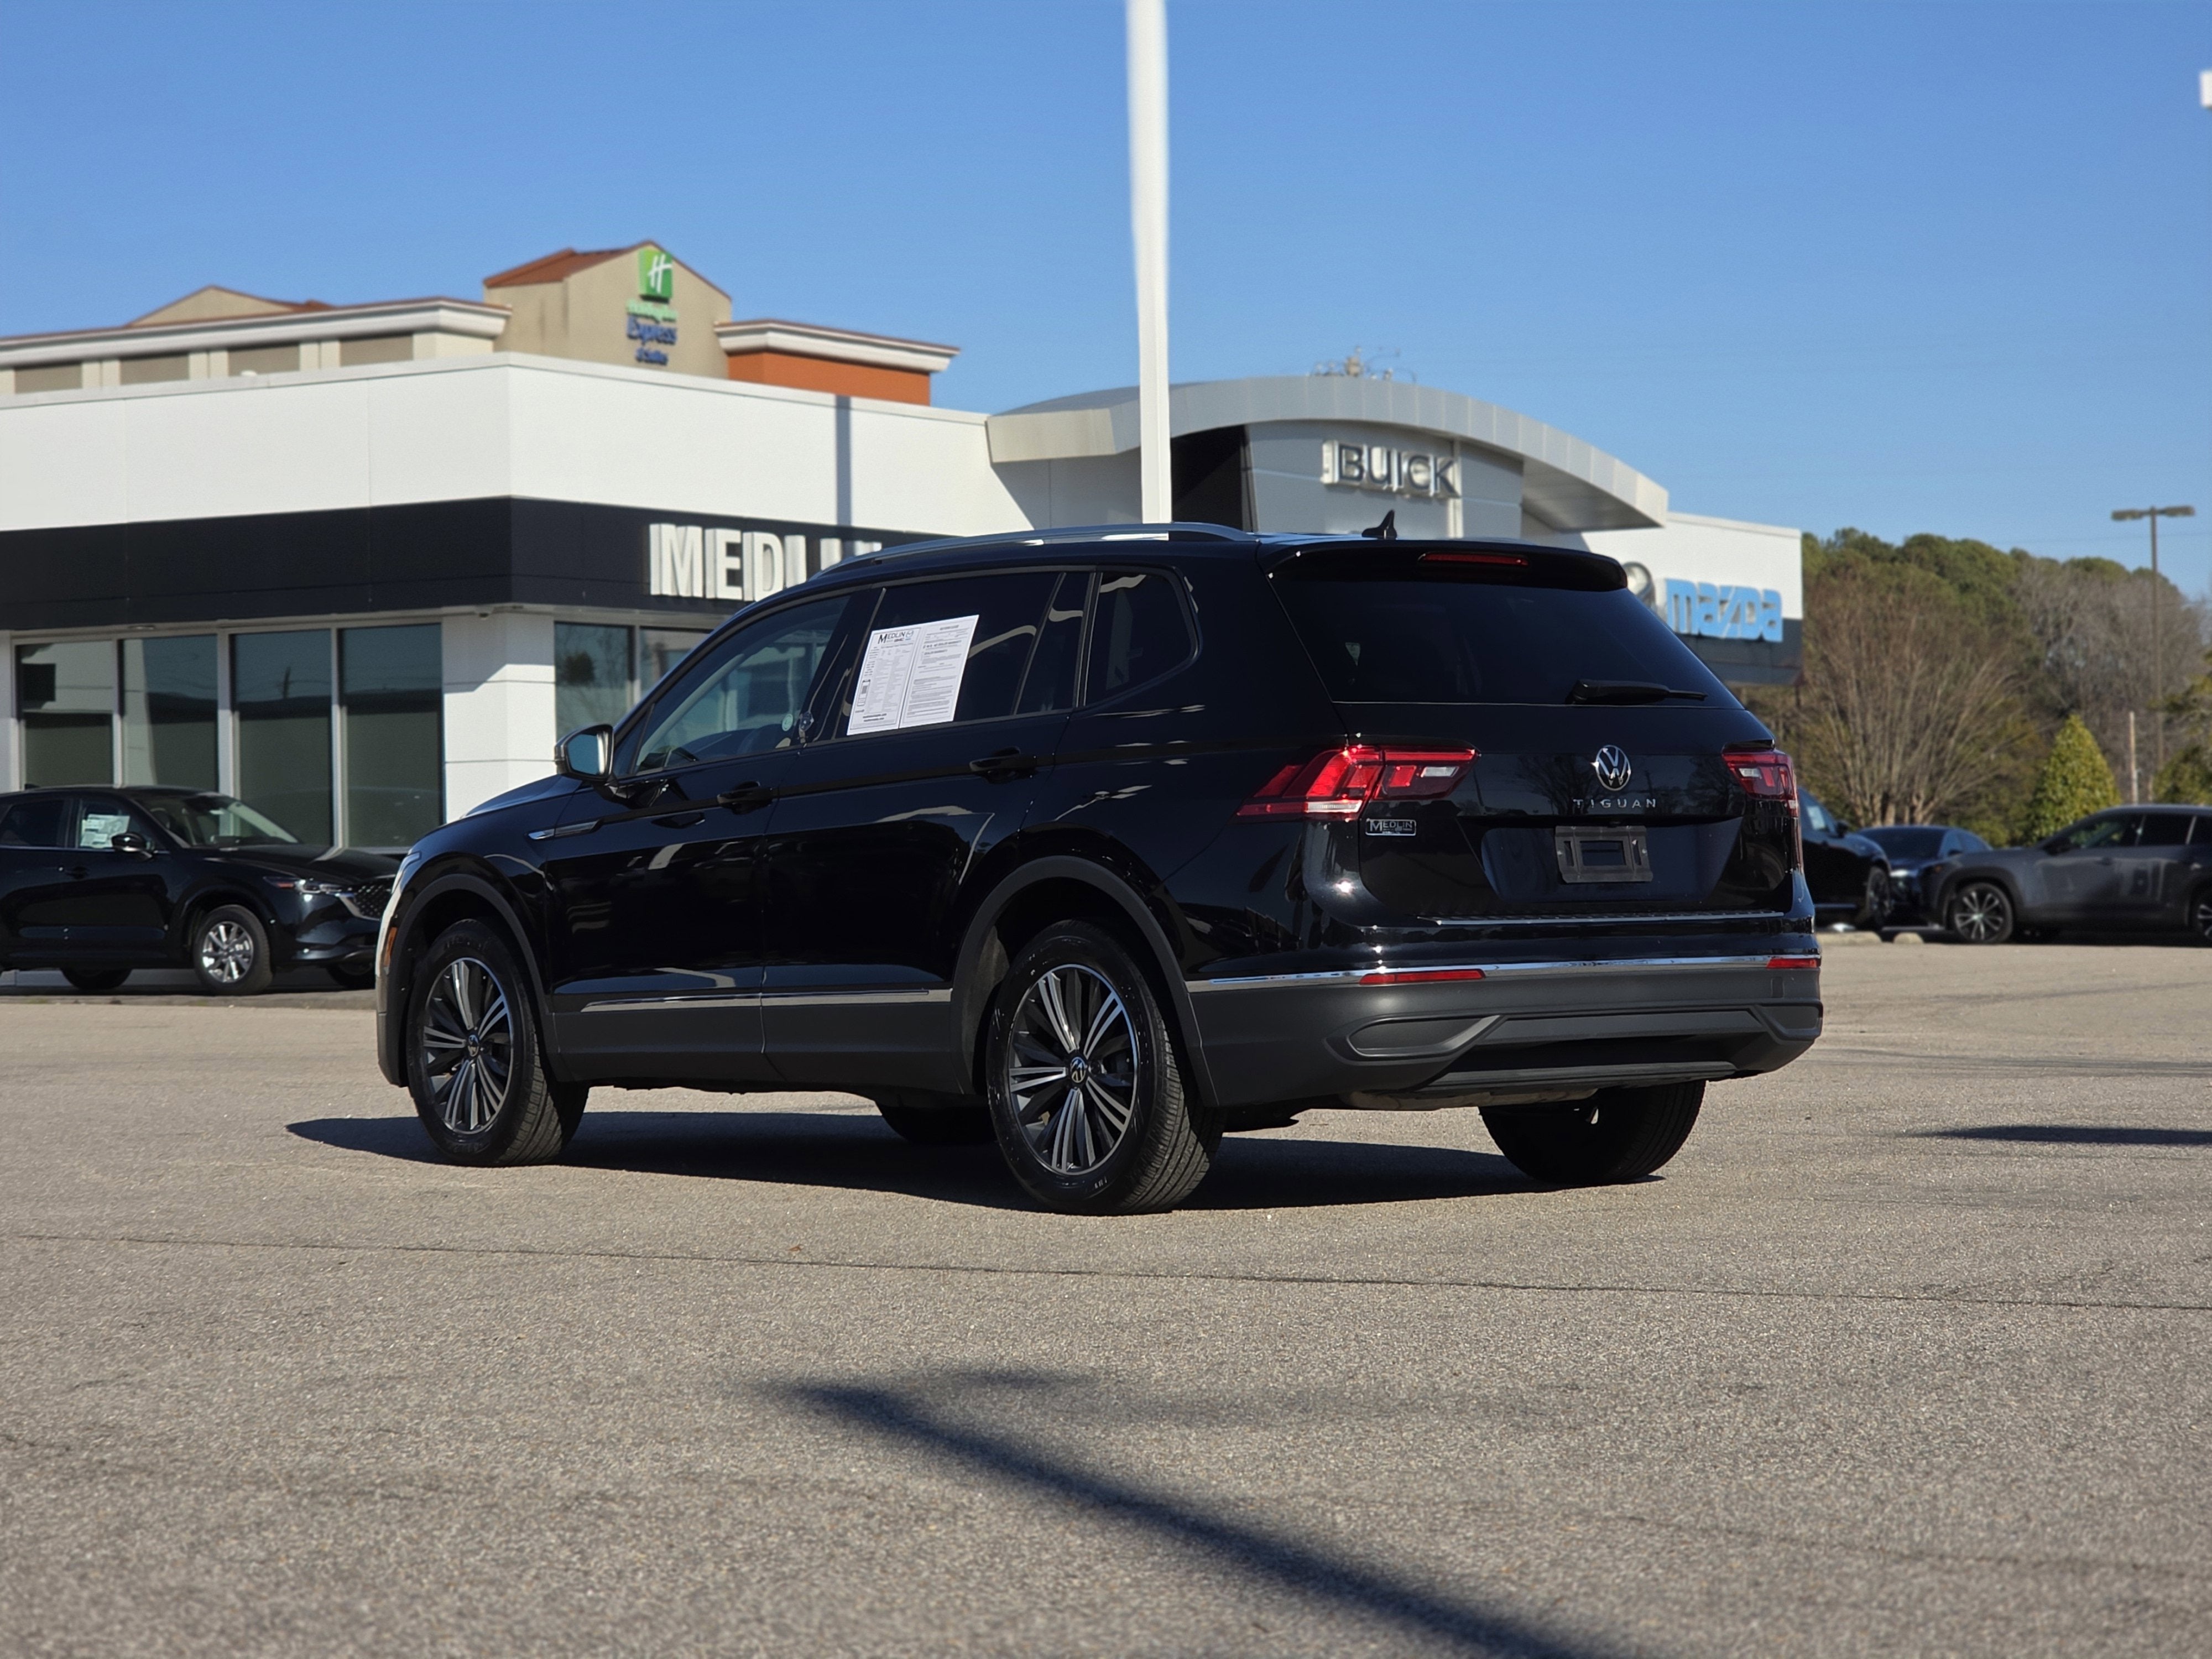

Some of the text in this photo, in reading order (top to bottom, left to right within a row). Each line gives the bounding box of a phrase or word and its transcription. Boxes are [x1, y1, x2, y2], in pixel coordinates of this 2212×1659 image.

[1333, 441, 1461, 499] BUICK
[649, 523, 882, 602] MEDL
[878, 632, 906, 644] MEDLIN
[1573, 799, 1656, 808] TIGUAN
[1370, 820, 1413, 832] MEDLIN
